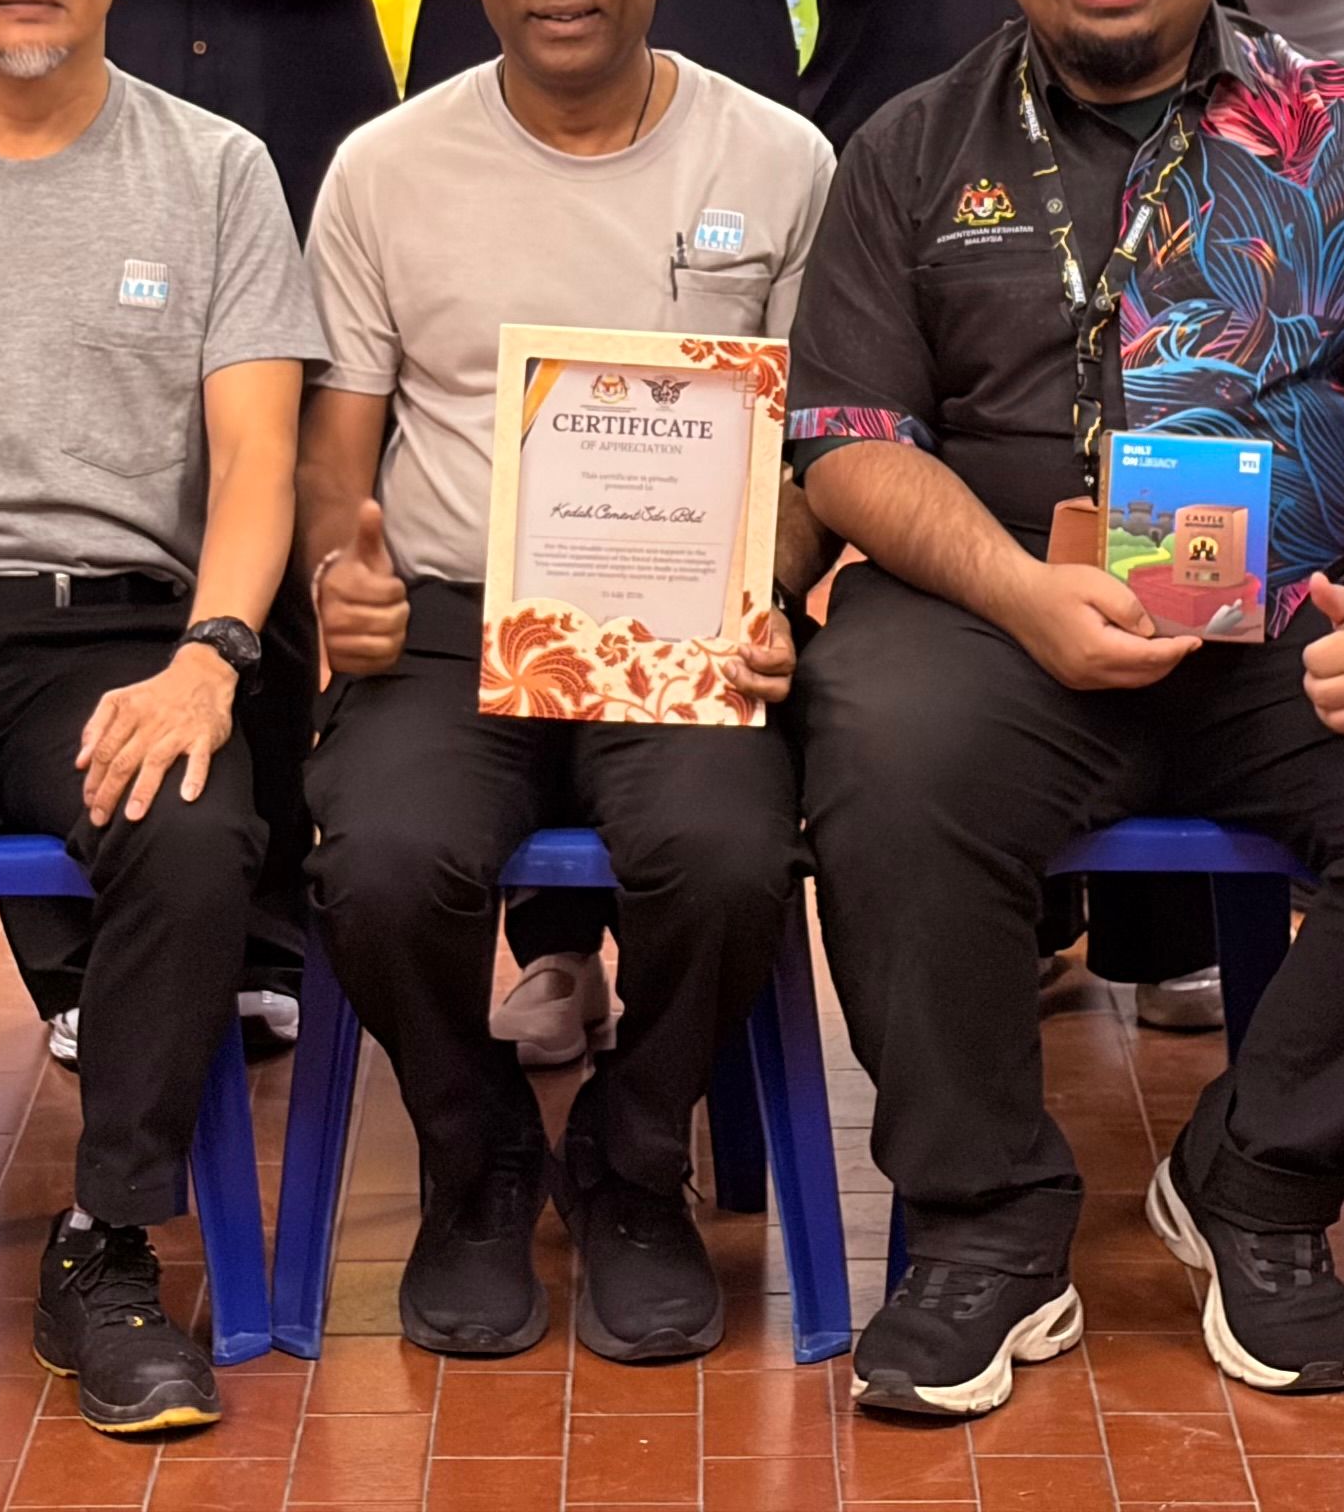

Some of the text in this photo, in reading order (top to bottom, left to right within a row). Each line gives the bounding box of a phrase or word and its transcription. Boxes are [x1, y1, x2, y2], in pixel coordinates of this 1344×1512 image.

[964, 234, 1003, 246] MALAYSIA
[552, 413, 713, 439] CERTIFICATE
[580, 440, 683, 455] OF APPRECIATION
[1123, 444, 1152, 455] BUILT
[1122, 456, 1178, 469] ON LEGACY
[550, 502, 707, 523] Kedah Cement Sdn Bhd
[1186, 514, 1224, 523] CASTLE
